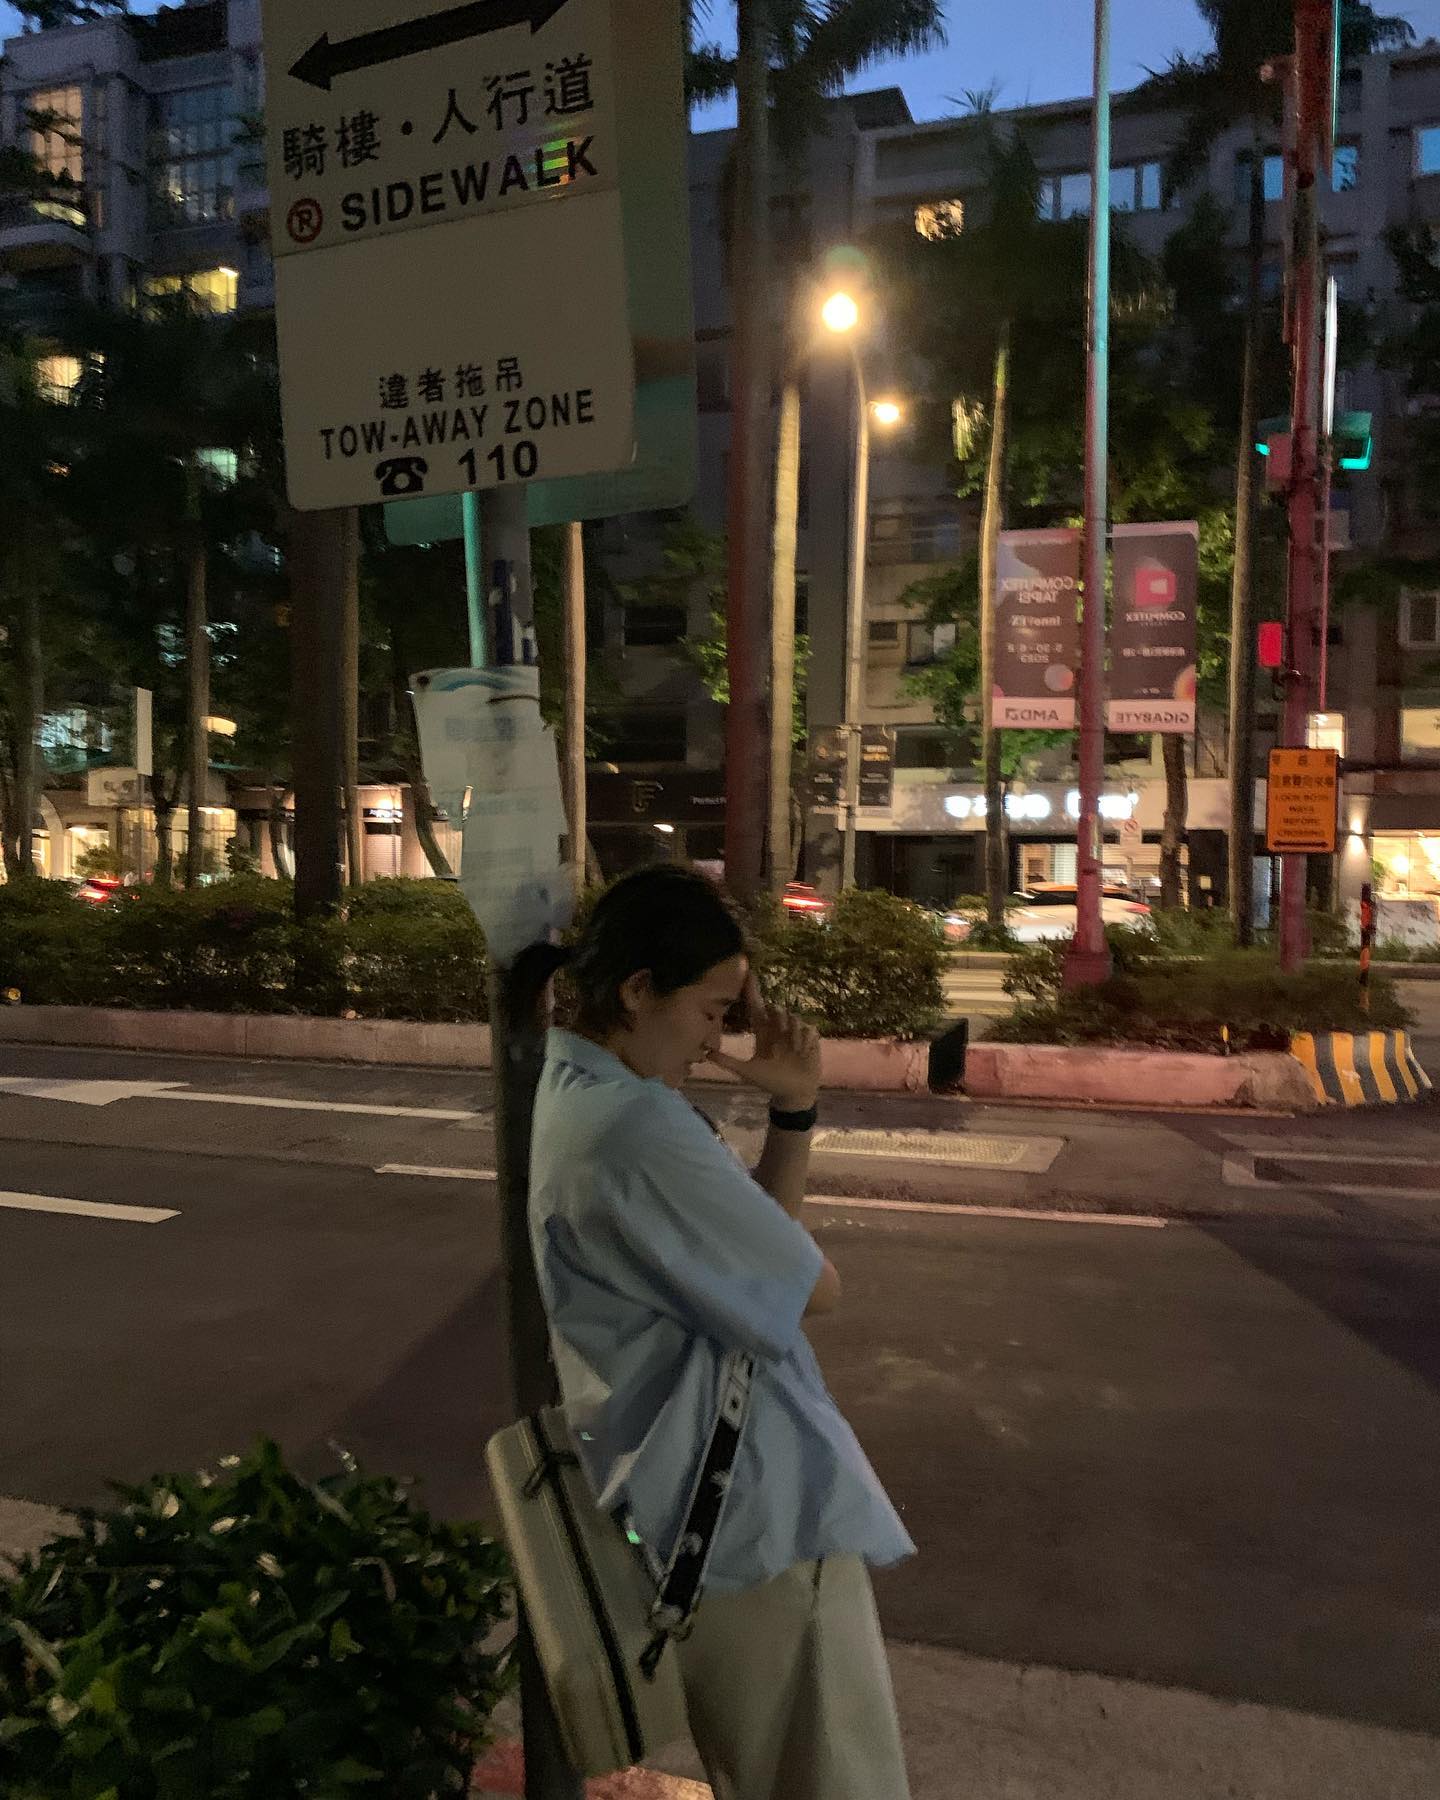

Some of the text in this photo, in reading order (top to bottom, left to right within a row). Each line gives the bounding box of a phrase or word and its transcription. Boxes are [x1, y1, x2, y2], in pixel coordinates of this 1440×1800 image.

[341, 135, 598, 232] SIDEWALK
[379, 357, 523, 409] 違者拖吊
[320, 389, 595, 460] TOW-AWAY ZONE
[457, 441, 538, 485] 110
